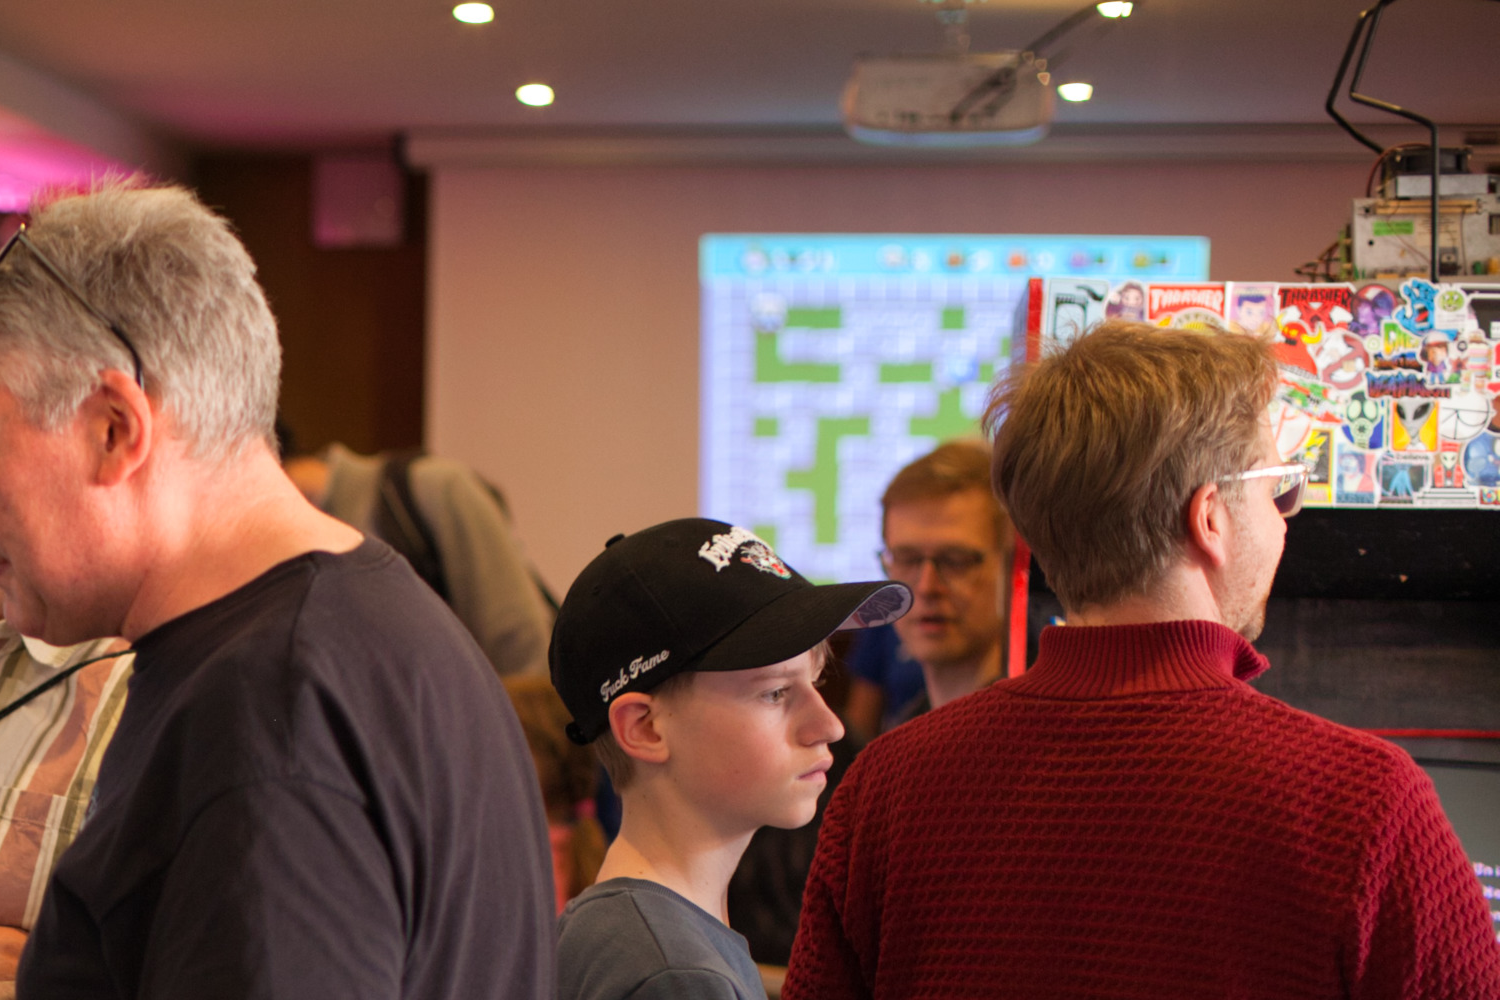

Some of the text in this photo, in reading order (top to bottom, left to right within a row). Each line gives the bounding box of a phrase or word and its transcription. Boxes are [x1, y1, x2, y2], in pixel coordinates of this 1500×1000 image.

[1150, 288, 1223, 316] THRASHER
[1278, 288, 1351, 310] THRASHER
[600, 649, 670, 703] Fuck Fame
